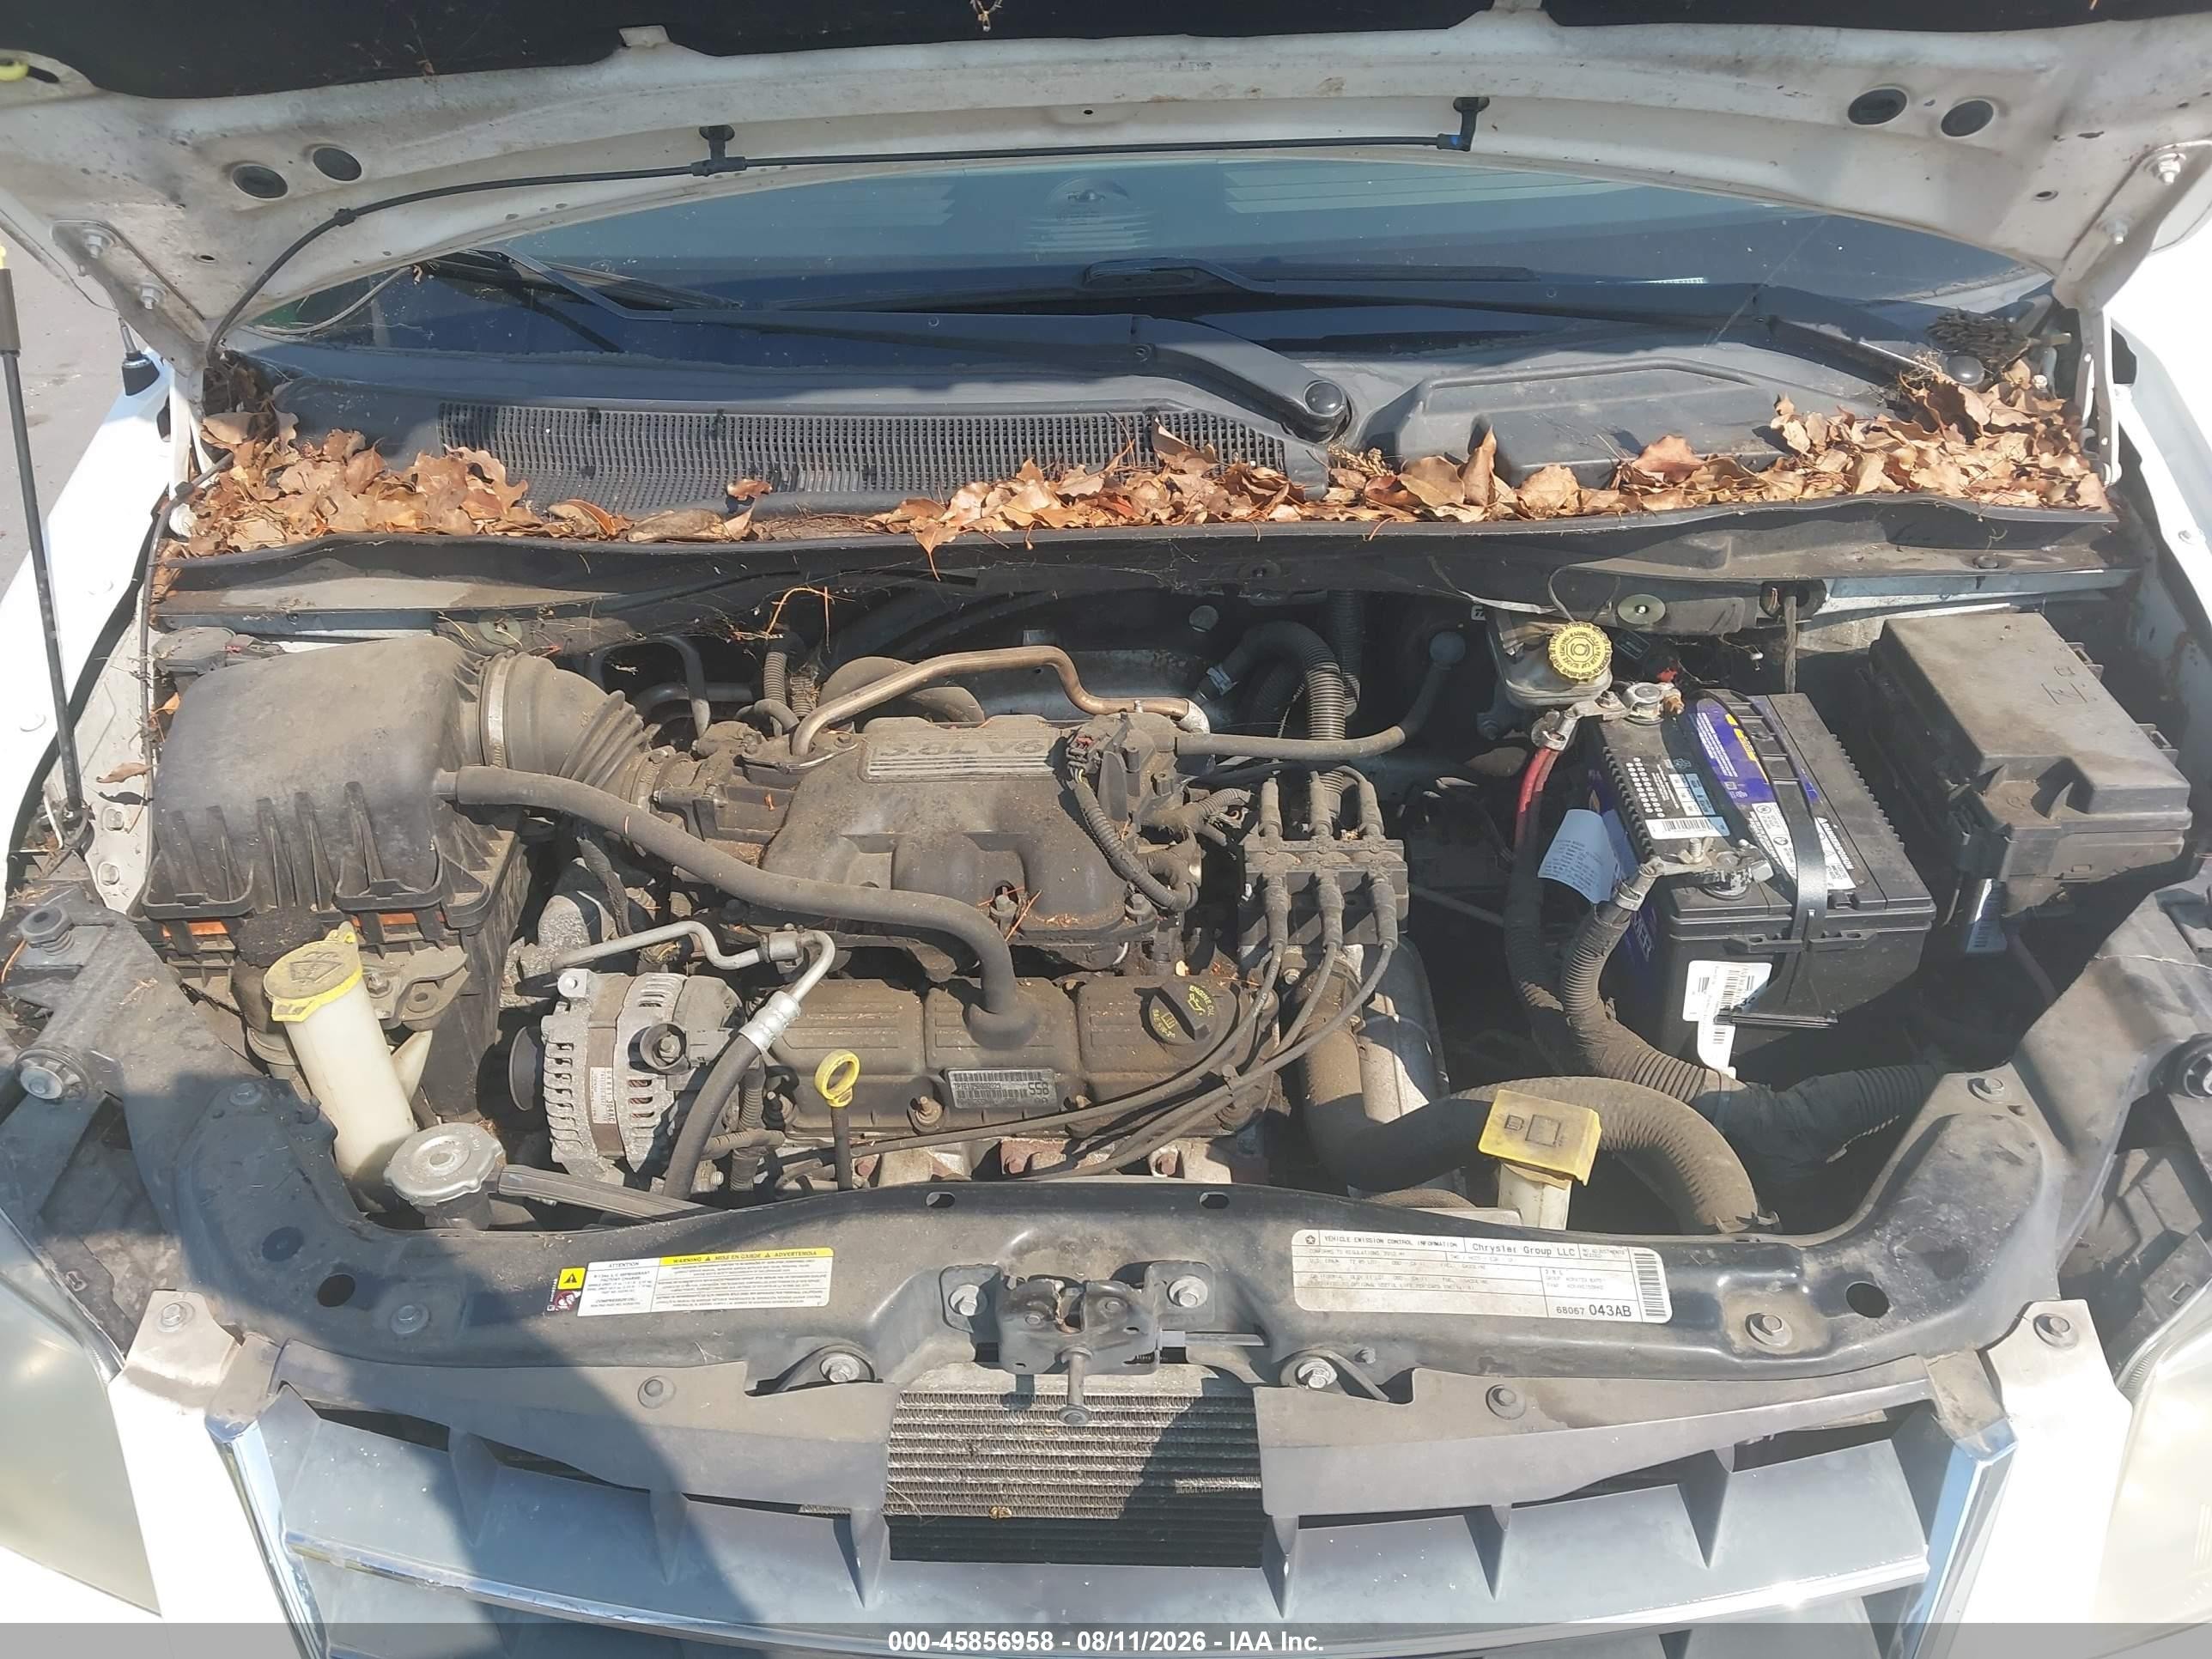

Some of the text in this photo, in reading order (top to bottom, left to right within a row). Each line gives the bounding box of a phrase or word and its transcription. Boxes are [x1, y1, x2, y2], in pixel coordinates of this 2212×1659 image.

[1188, 985, 1215, 1018] ENGINE OIL
[1417, 1239, 1458, 1248] INFORMATION
[1472, 1243, 1576, 1257] Chrysler Group LLC
[1556, 1304, 1632, 1317] 68067 043AB
